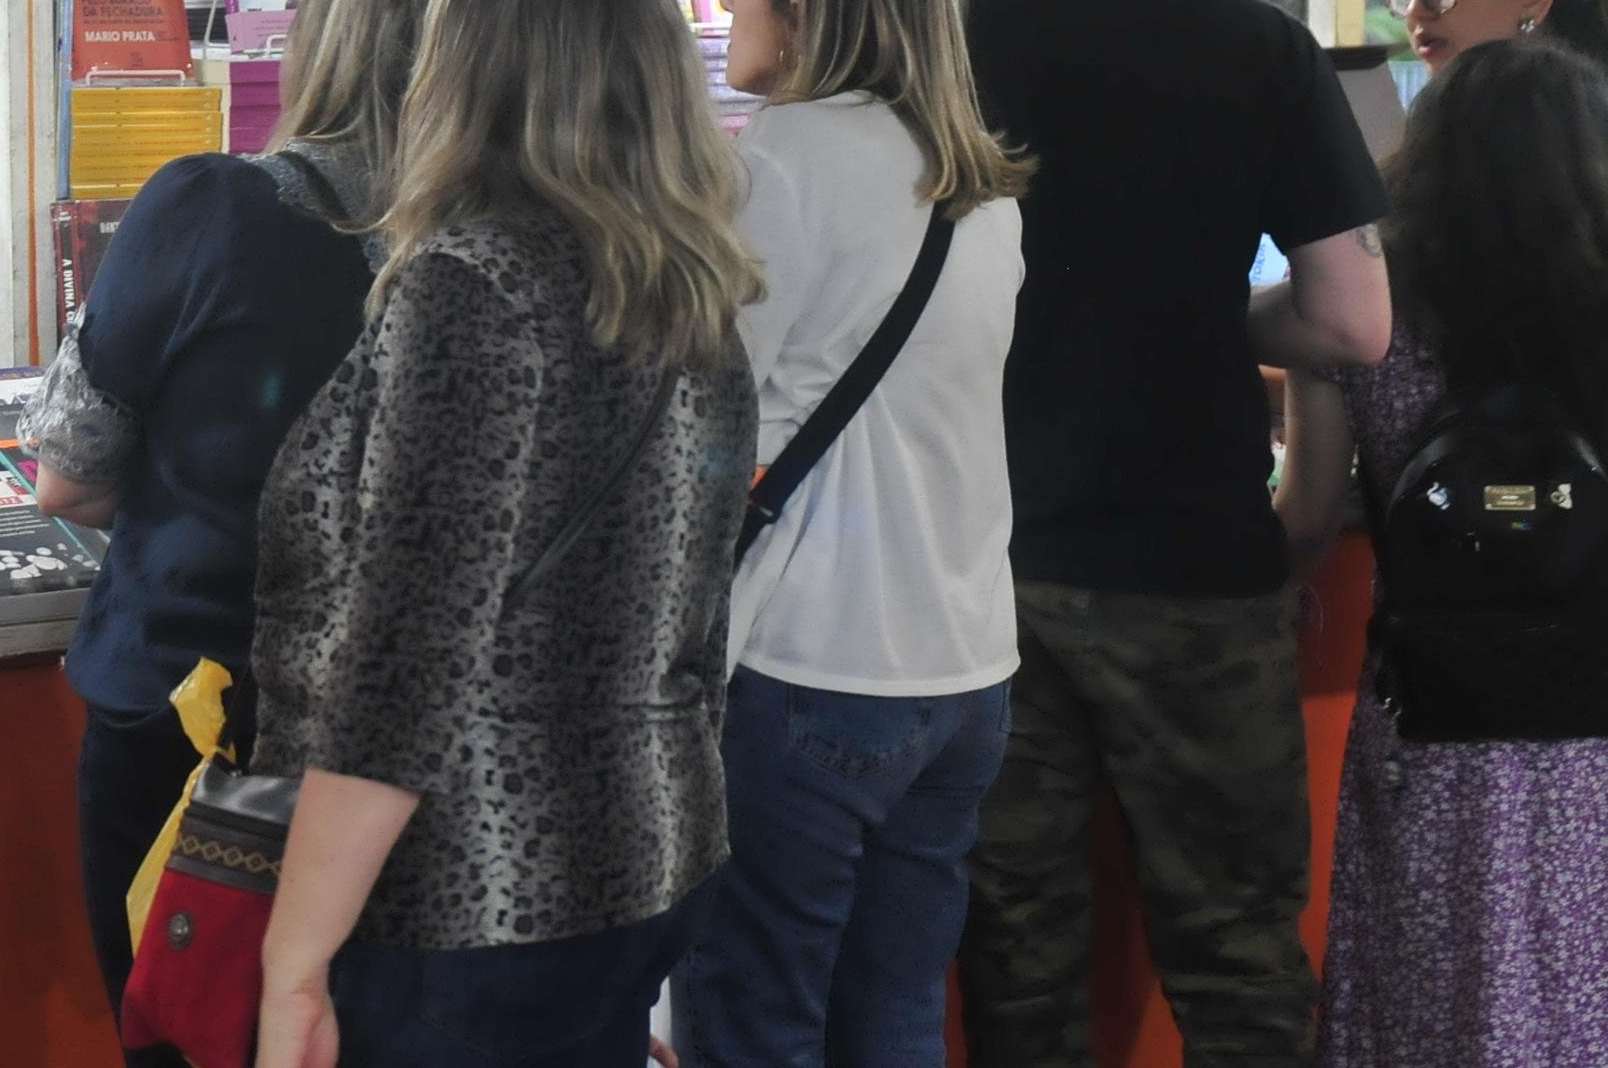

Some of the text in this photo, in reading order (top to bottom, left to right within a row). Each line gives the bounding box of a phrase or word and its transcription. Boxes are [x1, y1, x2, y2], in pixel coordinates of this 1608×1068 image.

[85, 30, 156, 42] MARIO PRATA
[63, 270, 75, 308] DIVINA
